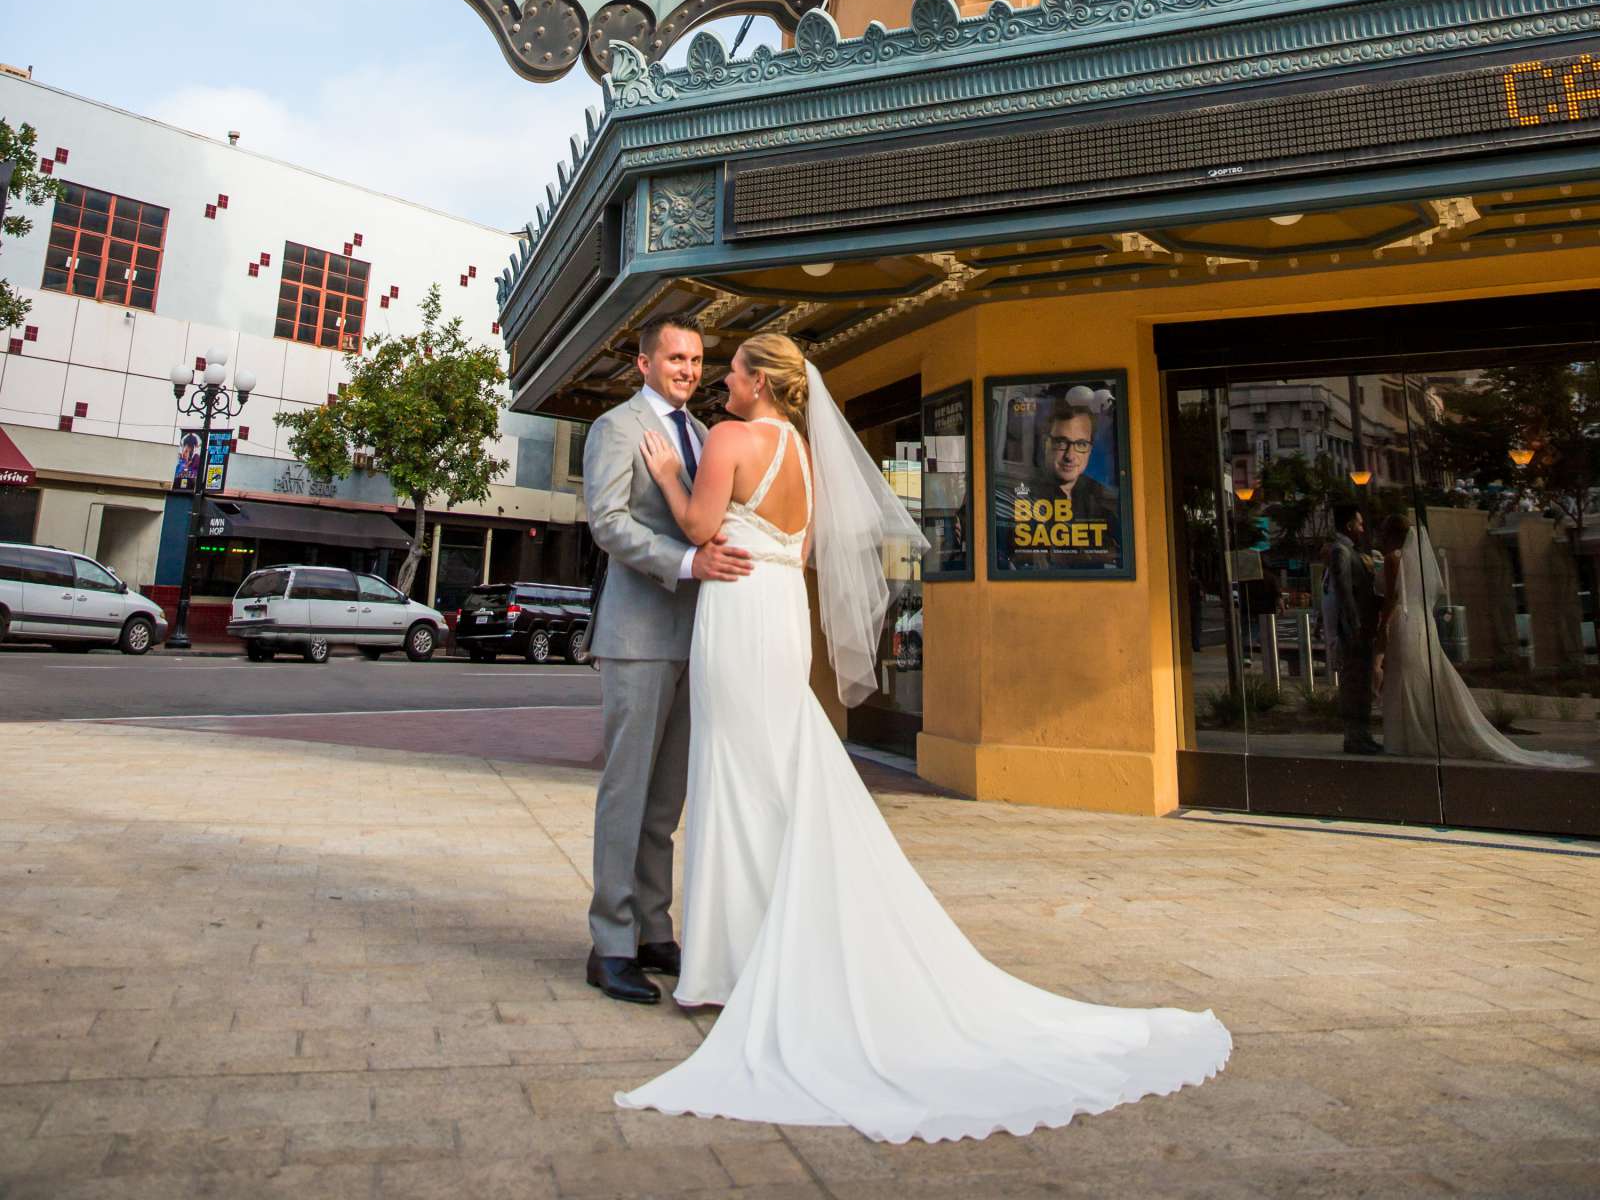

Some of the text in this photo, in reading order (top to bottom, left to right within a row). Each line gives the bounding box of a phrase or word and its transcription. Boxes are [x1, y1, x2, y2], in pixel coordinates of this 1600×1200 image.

[1014, 498, 1073, 522] BOB
[210, 518, 225, 527] AWN
[209, 527, 224, 536] HOP
[1014, 523, 1107, 546] SAGET
